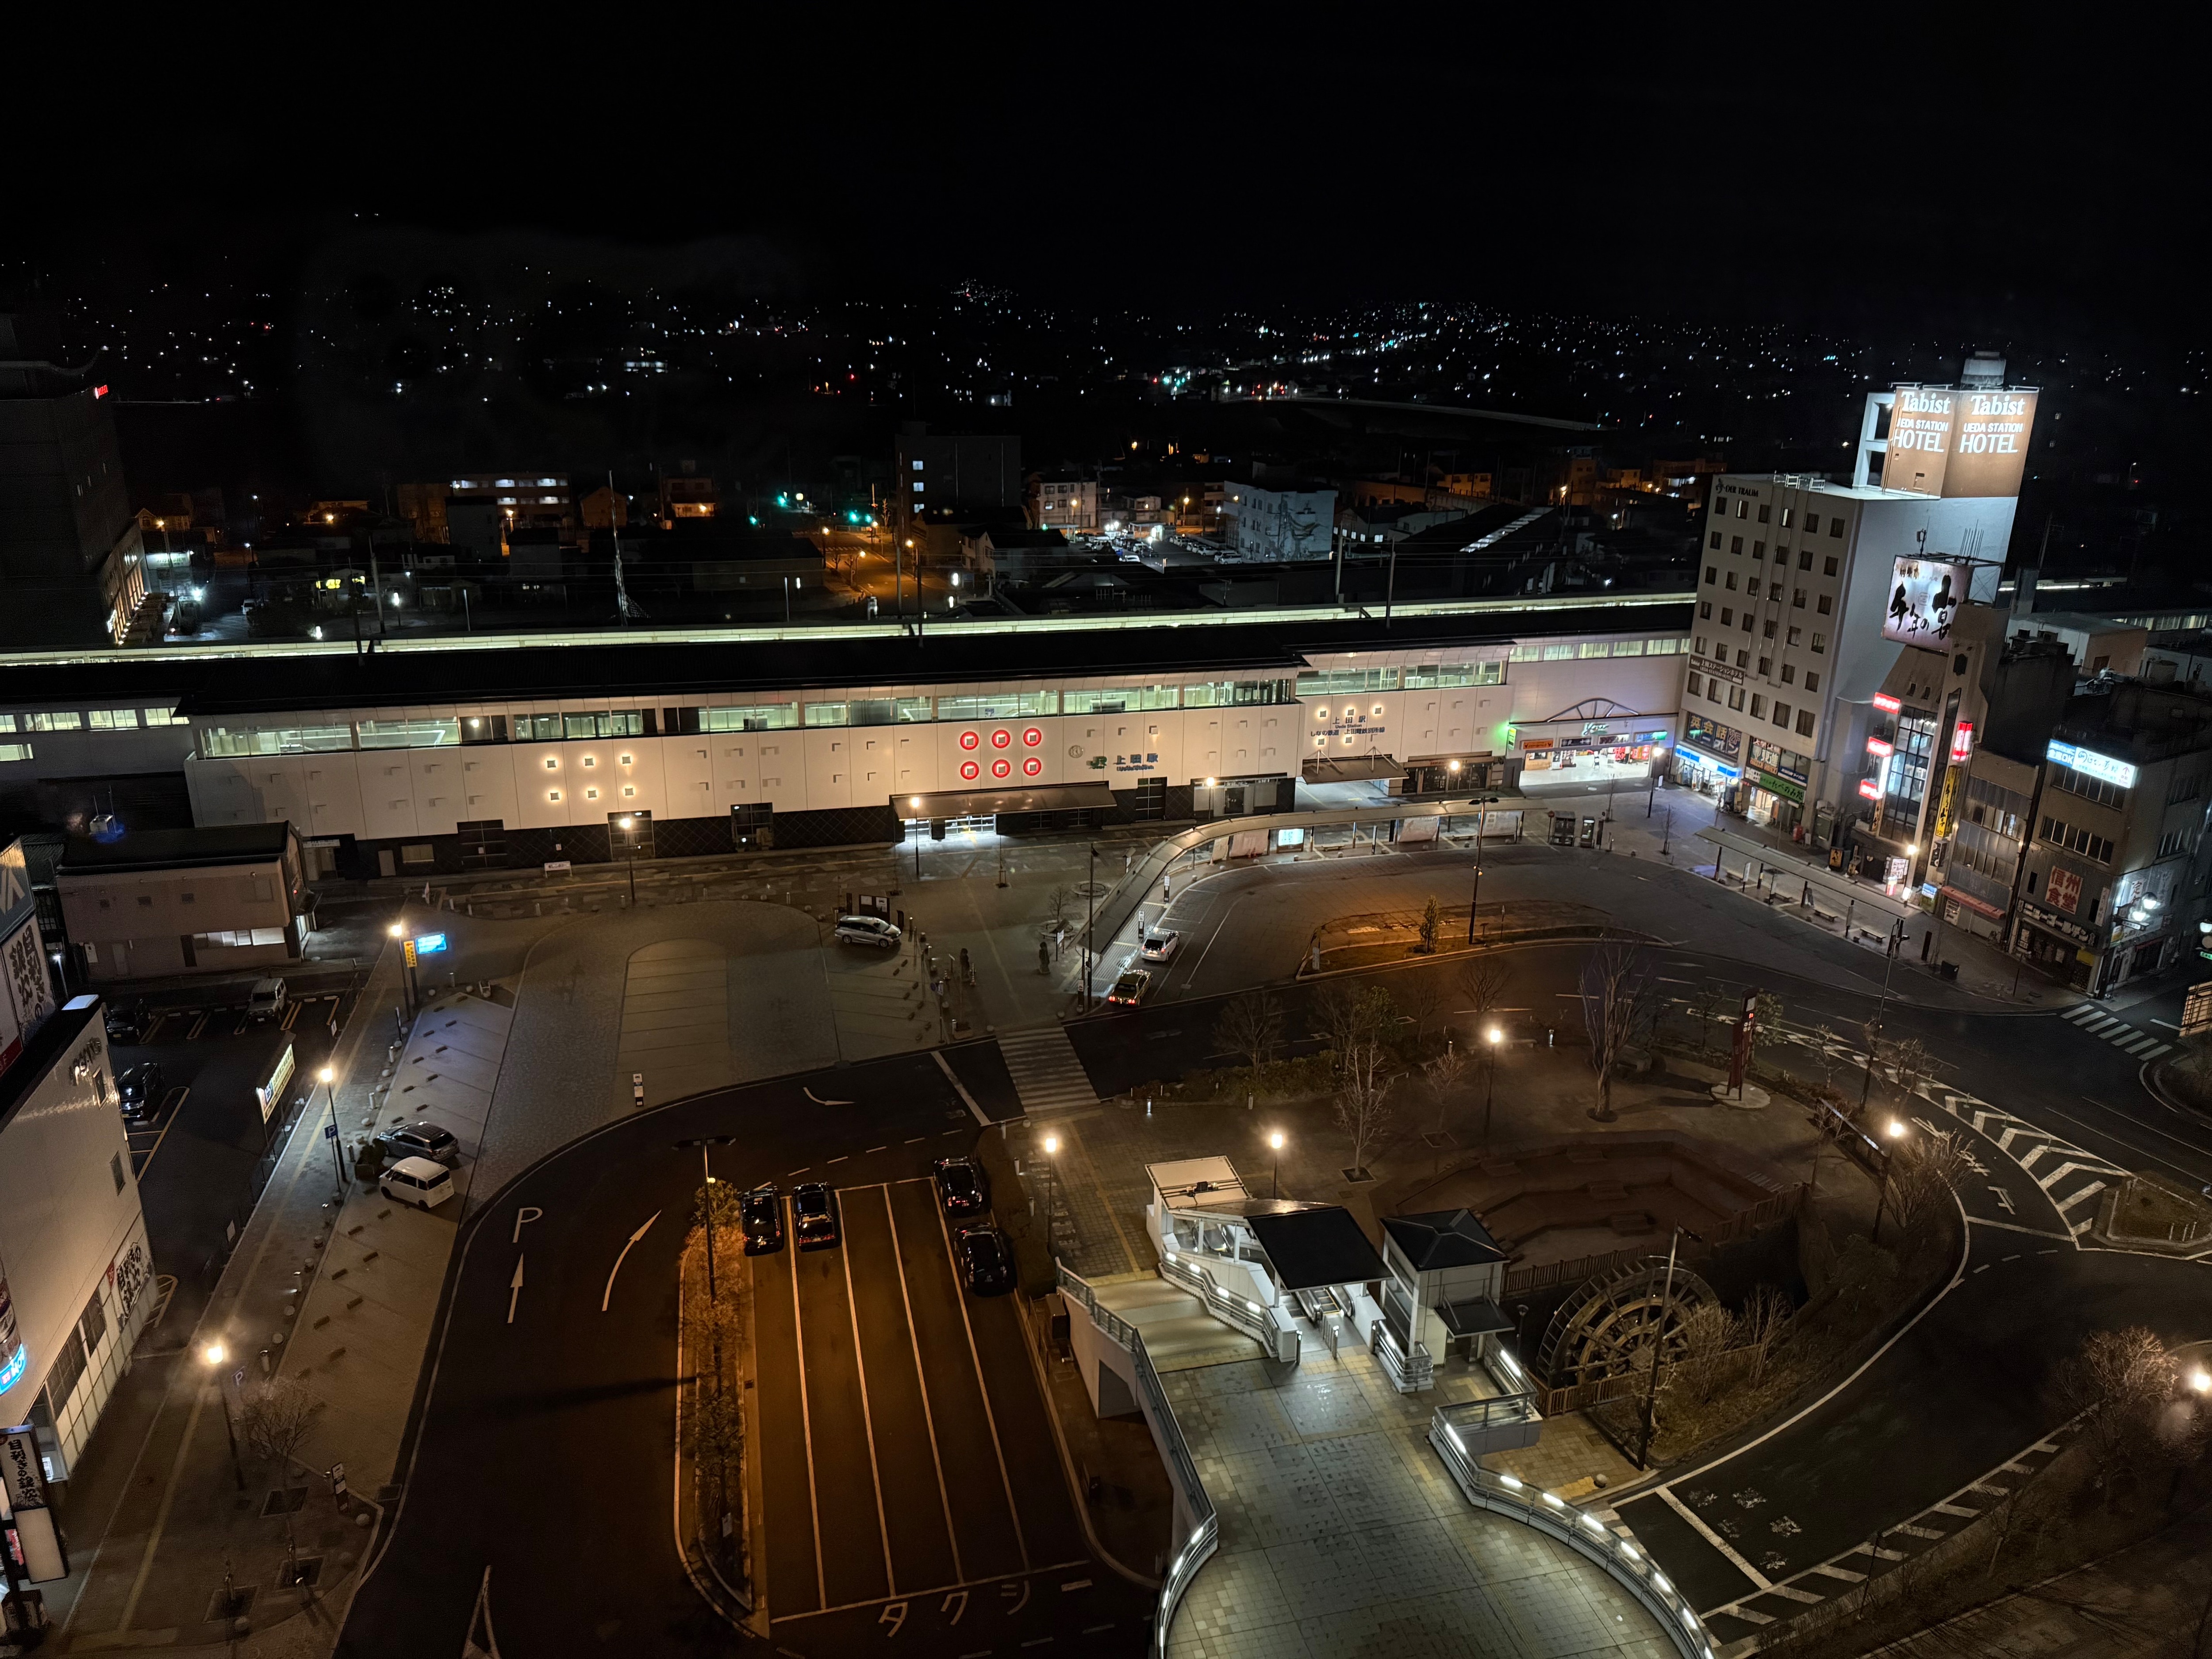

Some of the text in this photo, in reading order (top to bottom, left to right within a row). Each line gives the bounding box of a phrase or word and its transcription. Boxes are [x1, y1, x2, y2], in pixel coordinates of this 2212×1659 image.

[1901, 391, 1951, 415] Tabist
[1970, 395, 2025, 415] Tabist
[1916, 420, 1948, 432] STATION
[1963, 423, 2023, 433] UEDA STATION
[1893, 429, 1944, 453] HOTEL
[1959, 434, 2019, 453] HOTEL
[1333, 715, 1366, 725] 上田駅
[1690, 715, 1728, 741] 英会話
[1088, 756, 1107, 769] JR
[1114, 753, 1158, 764] 上田駅
[2051, 868, 2081, 894] 信州
[2046, 887, 2078, 913] 食堂
[328, 1126, 336, 1137] P
[513, 1207, 543, 1243] P
[8, 1439, 38, 1501] 目利きの銀次
[878, 1578, 1093, 1638] タクシー
